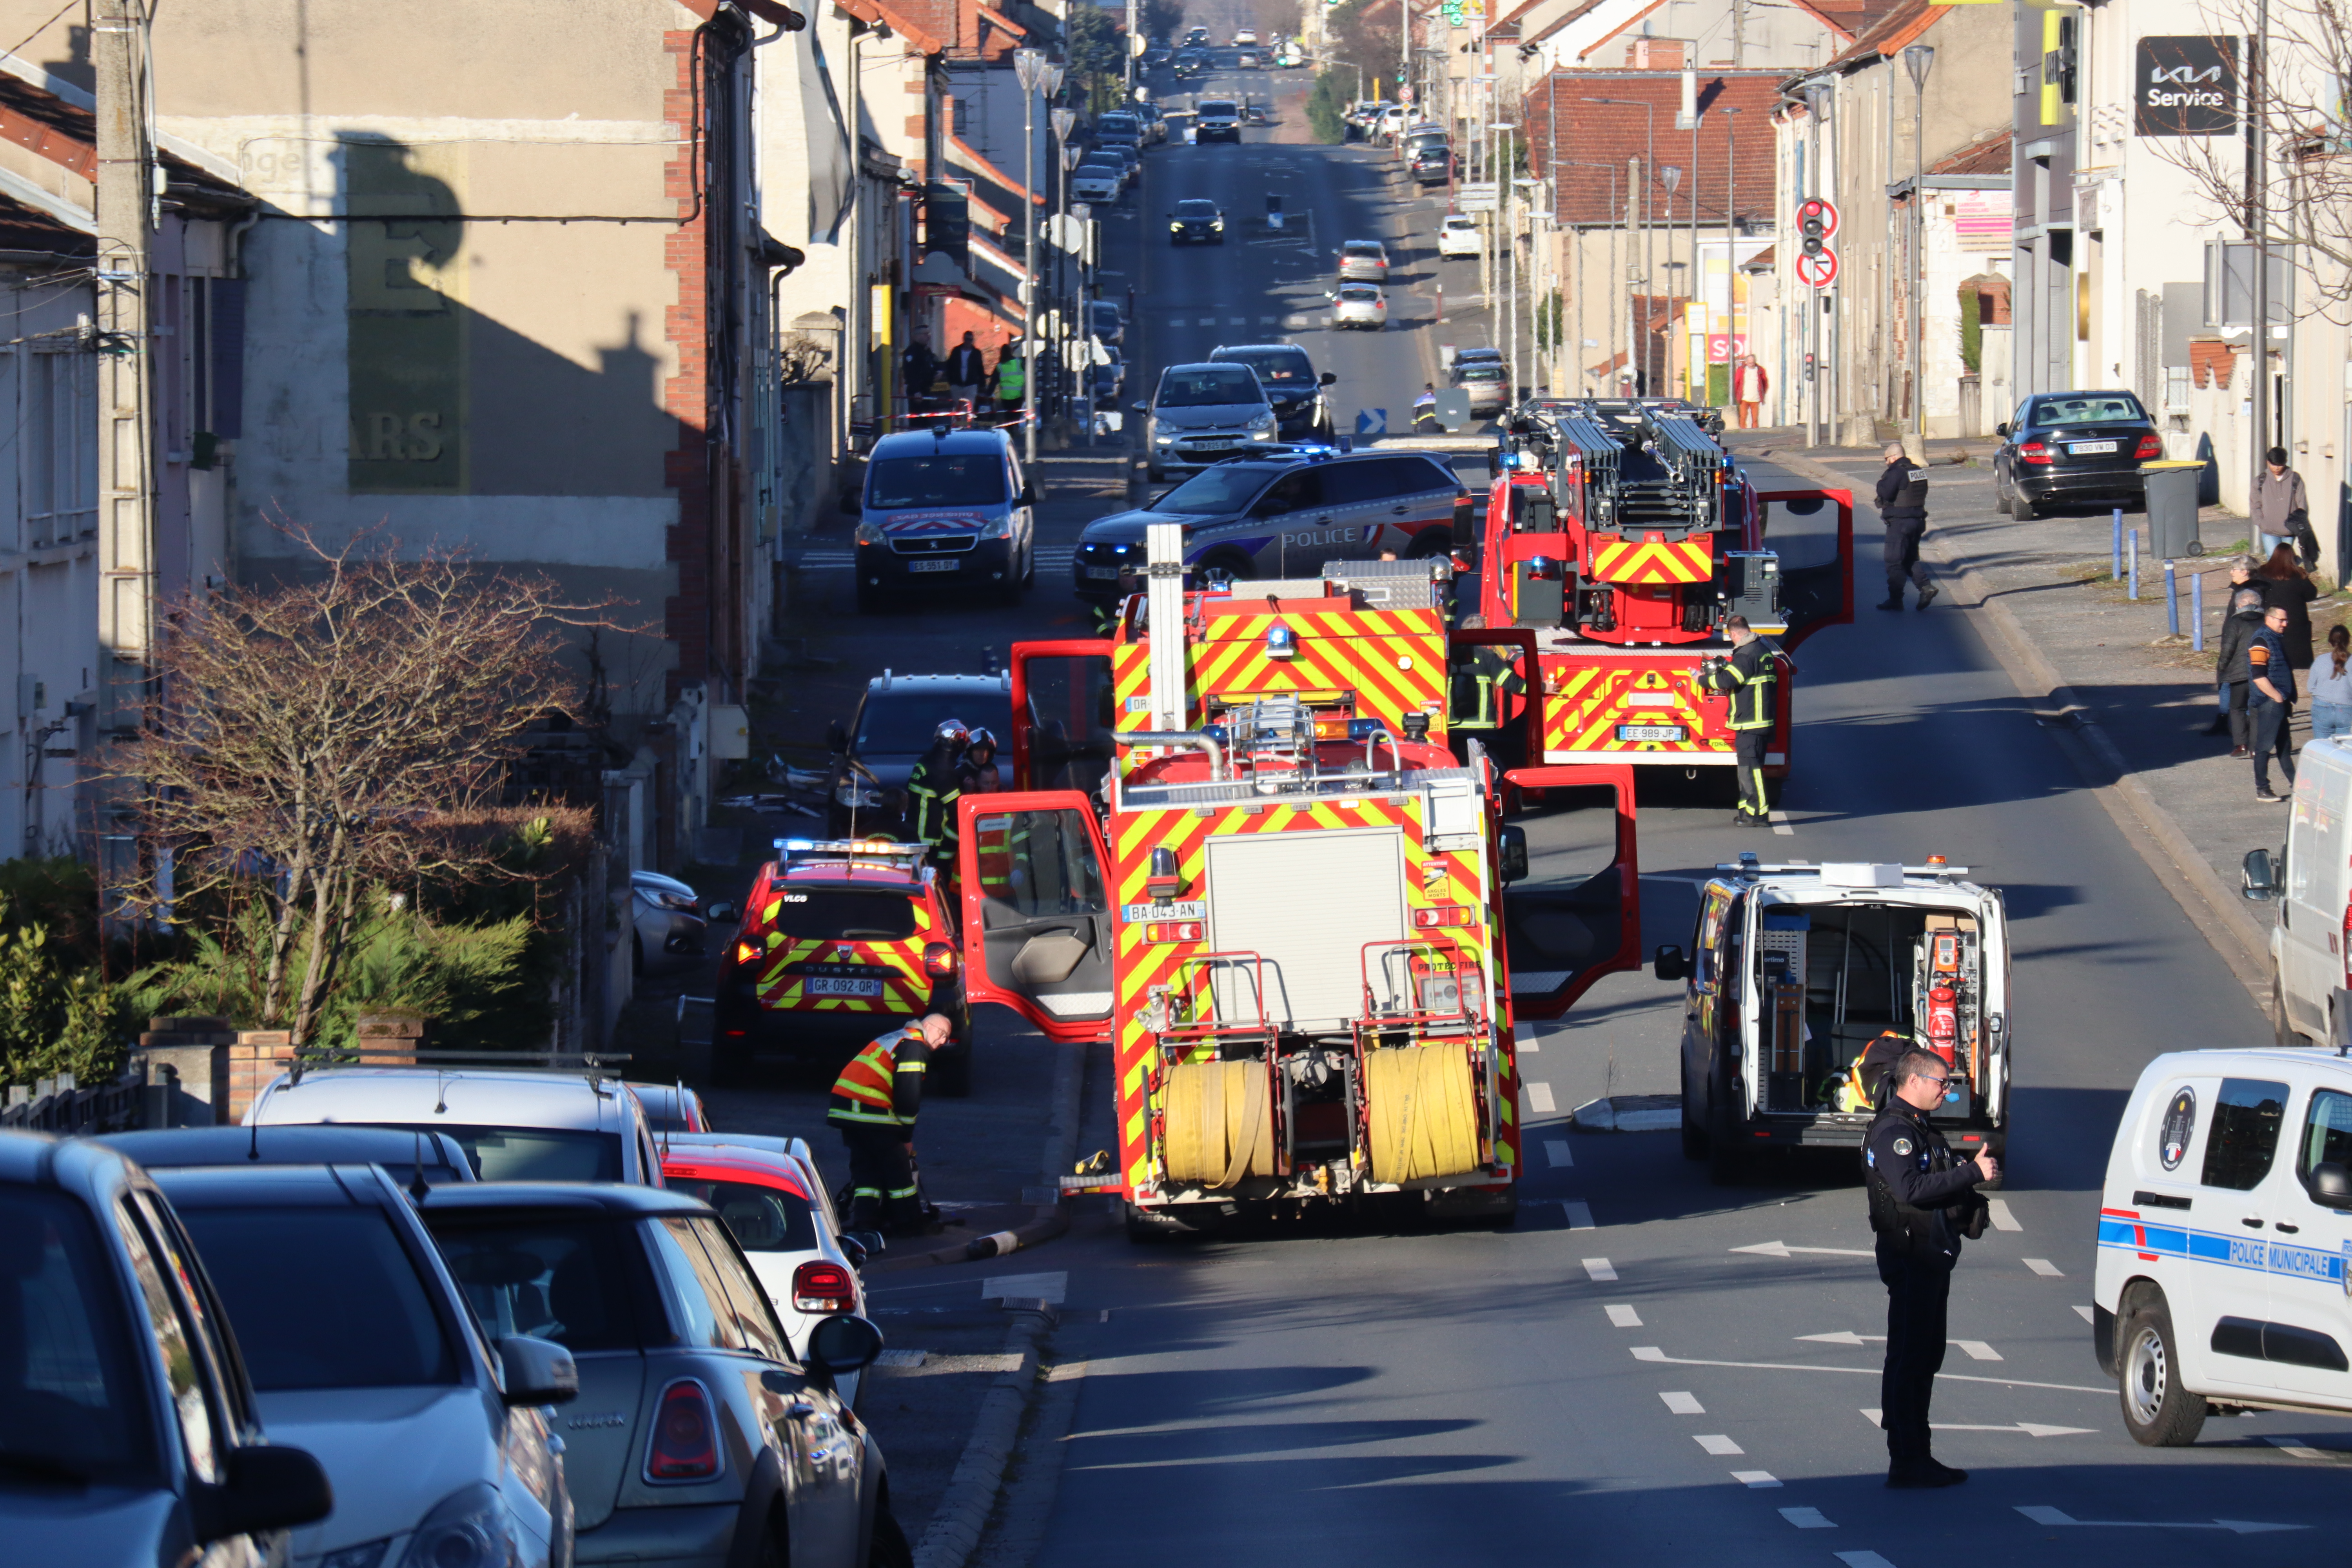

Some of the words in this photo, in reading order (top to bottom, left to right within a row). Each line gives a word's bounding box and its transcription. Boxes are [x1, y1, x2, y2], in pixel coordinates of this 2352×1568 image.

[2148, 89, 2223, 107] Service
[1713, 340, 1746, 357] SO
[1910, 470, 1926, 480] POLICE
[1283, 528, 1357, 549] POLICE
[1627, 729, 1674, 738] EE-989-JP
[1132, 903, 1195, 919] BA-043-AN
[1418, 962, 1456, 971] PROTEC
[1459, 961, 1481, 969] FIRE
[2232, 1241, 2264, 1266] POLICE
[2268, 1247, 2328, 1276] MUNICIPALE
[568, 1413, 626, 1430] COOPER
